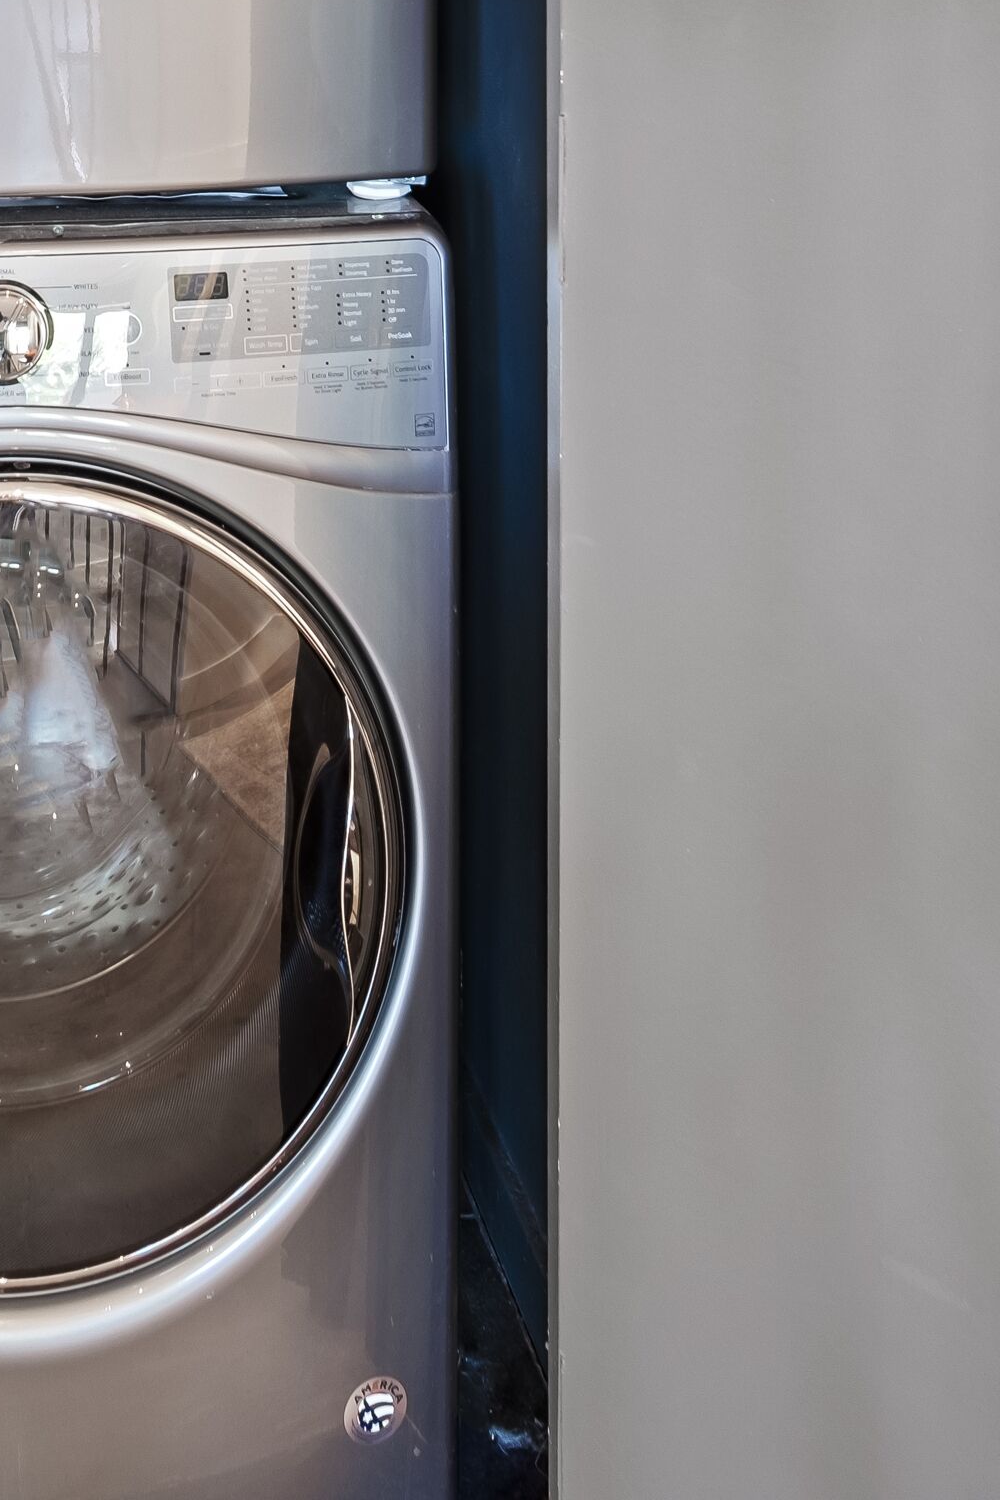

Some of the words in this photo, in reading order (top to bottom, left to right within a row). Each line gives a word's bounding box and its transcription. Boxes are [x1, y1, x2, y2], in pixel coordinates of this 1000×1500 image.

[343, 319, 357, 327] Light
[352, 368, 369, 377] Cycle
[370, 366, 389, 376] Signal
[394, 364, 417, 373] Control
[417, 362, 432, 371] Lock
[311, 371, 327, 380] Extra
[354, 1379, 404, 1405] AMERICA
